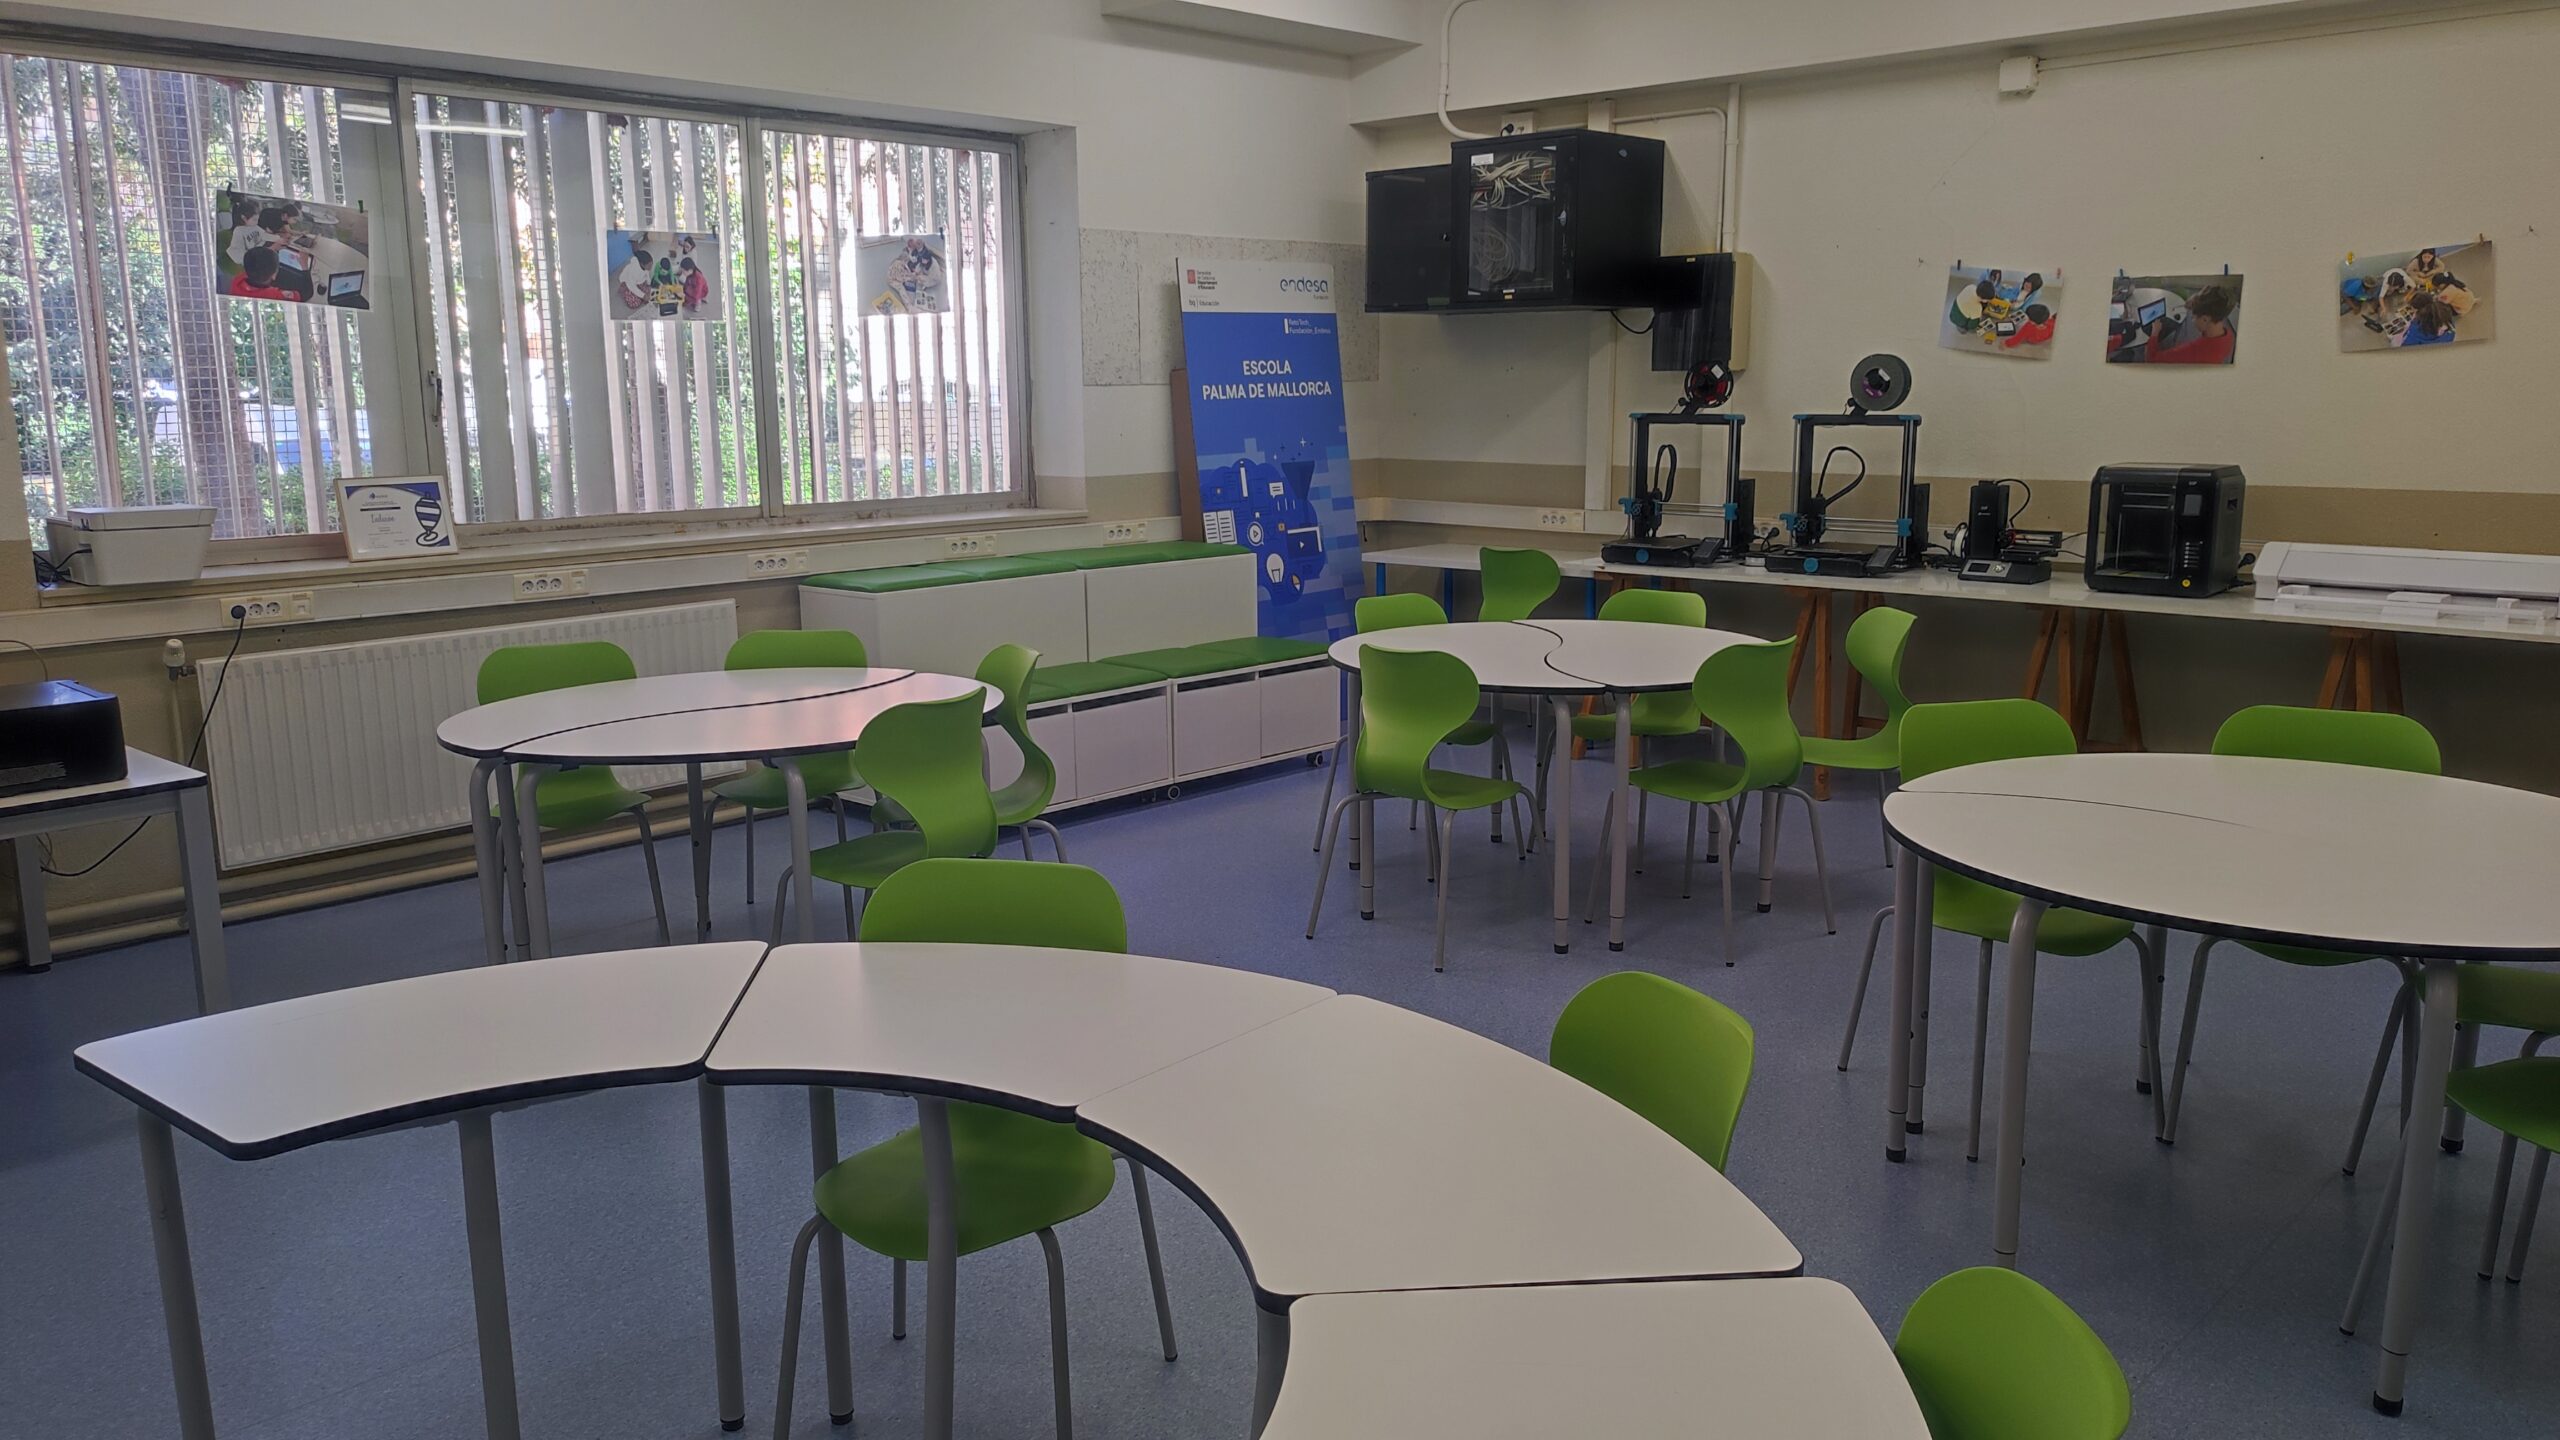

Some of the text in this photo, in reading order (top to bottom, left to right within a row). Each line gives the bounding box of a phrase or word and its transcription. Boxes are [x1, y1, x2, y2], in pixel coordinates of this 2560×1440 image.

[1280, 276, 1329, 293] endesa
[1242, 360, 1292, 375] ESCOLA
[1202, 381, 1332, 400] PALMA DE MALLORCA
